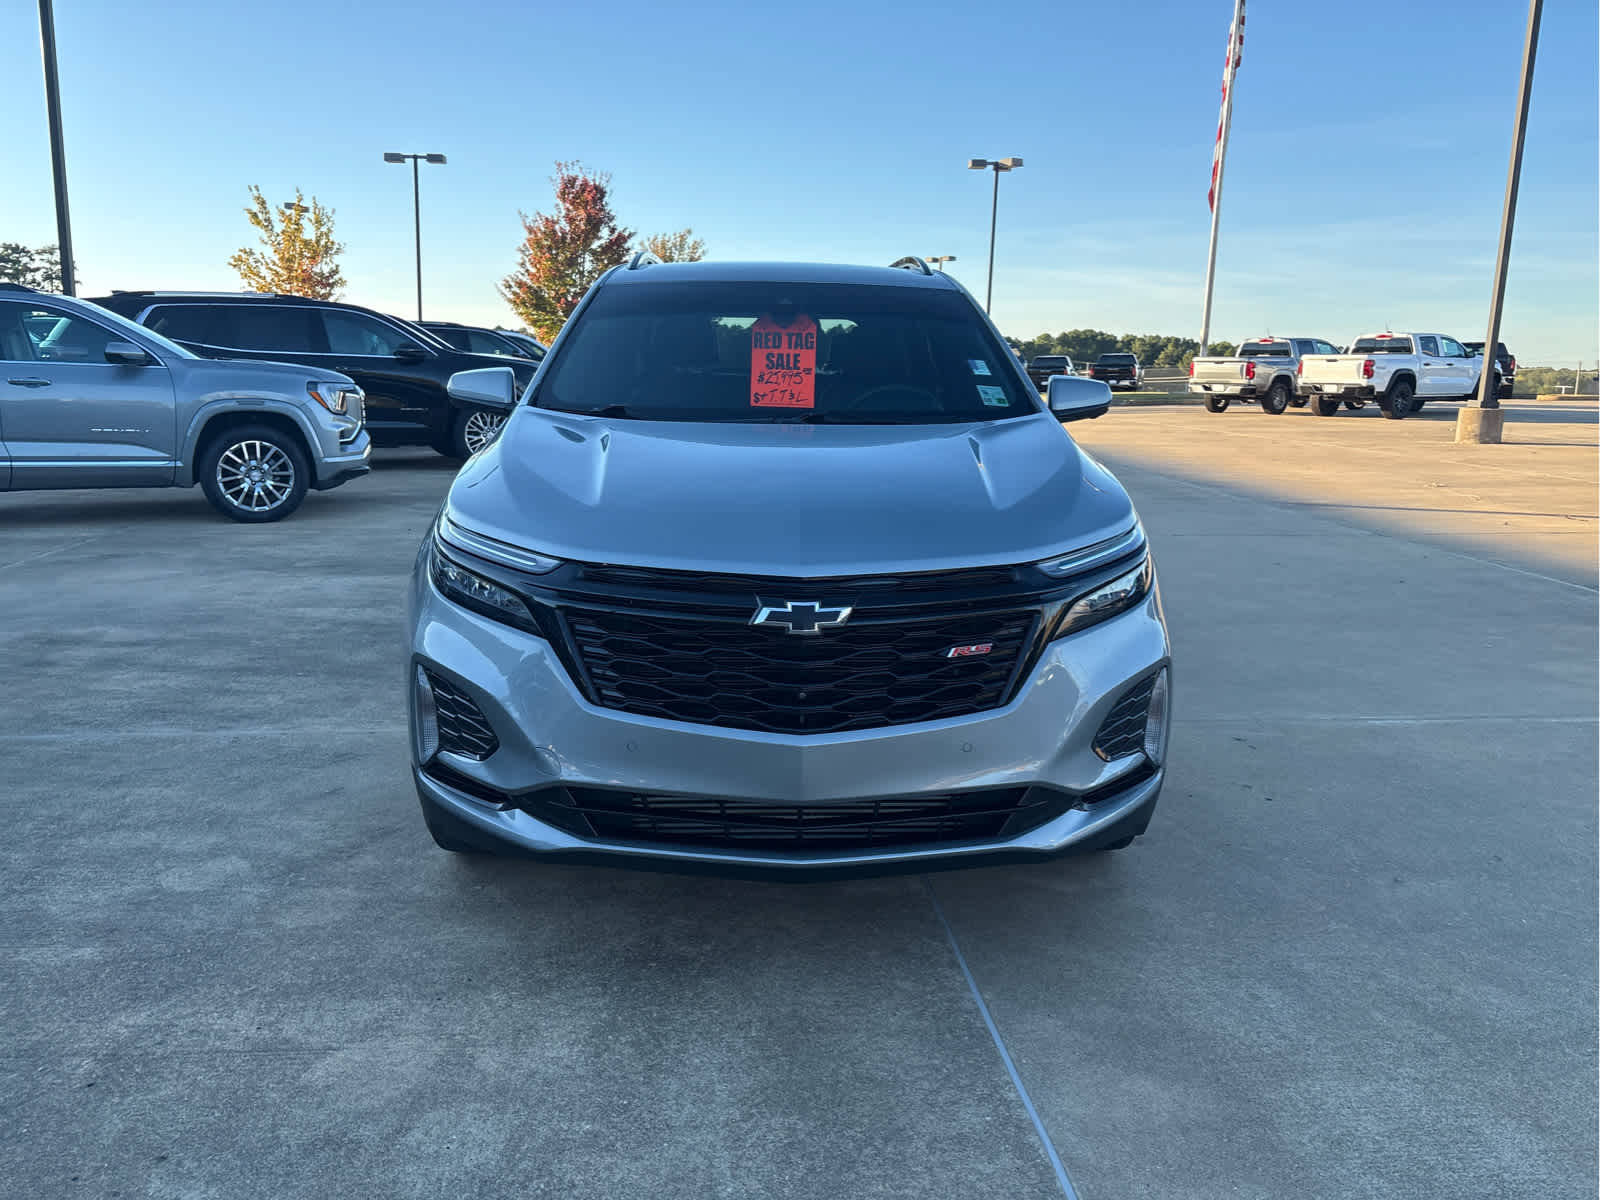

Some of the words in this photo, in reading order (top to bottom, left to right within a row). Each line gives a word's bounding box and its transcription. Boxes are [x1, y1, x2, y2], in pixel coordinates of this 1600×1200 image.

[753, 332, 782, 349] RED
[786, 332, 815, 350] TAG
[765, 352, 801, 370] SALE
[946, 643, 992, 658] RS
